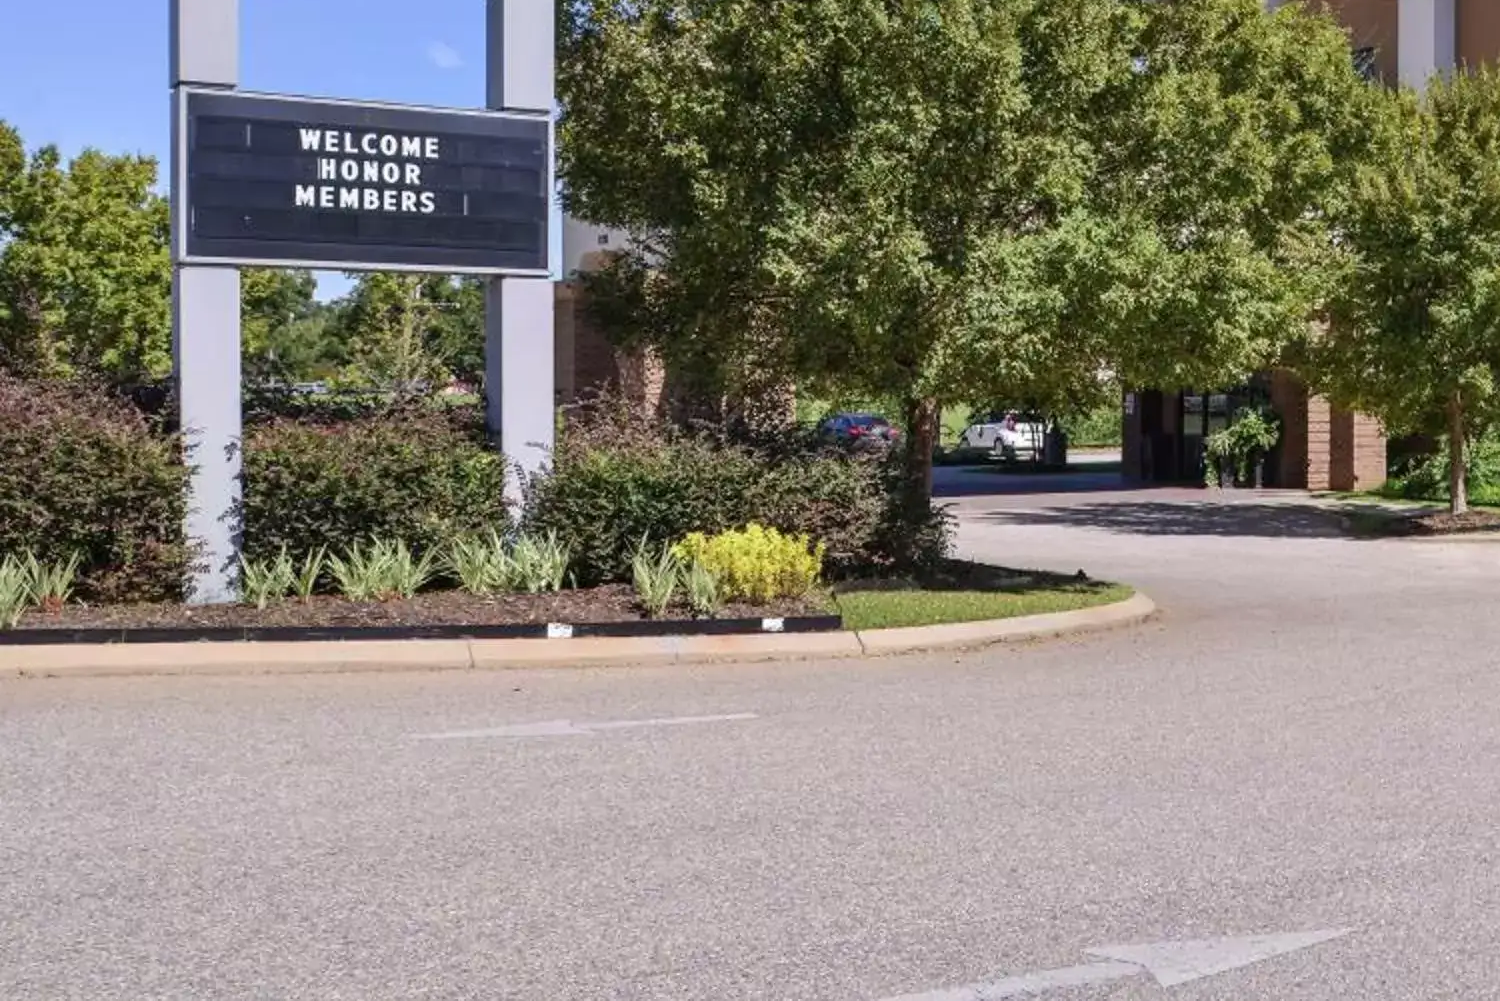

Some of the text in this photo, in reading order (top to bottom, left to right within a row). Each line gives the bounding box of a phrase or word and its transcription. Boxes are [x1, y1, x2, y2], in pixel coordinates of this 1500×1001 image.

[299, 128, 440, 160] WELCOME
[319, 158, 422, 185] HONOR
[294, 184, 436, 214] MEMBERS
